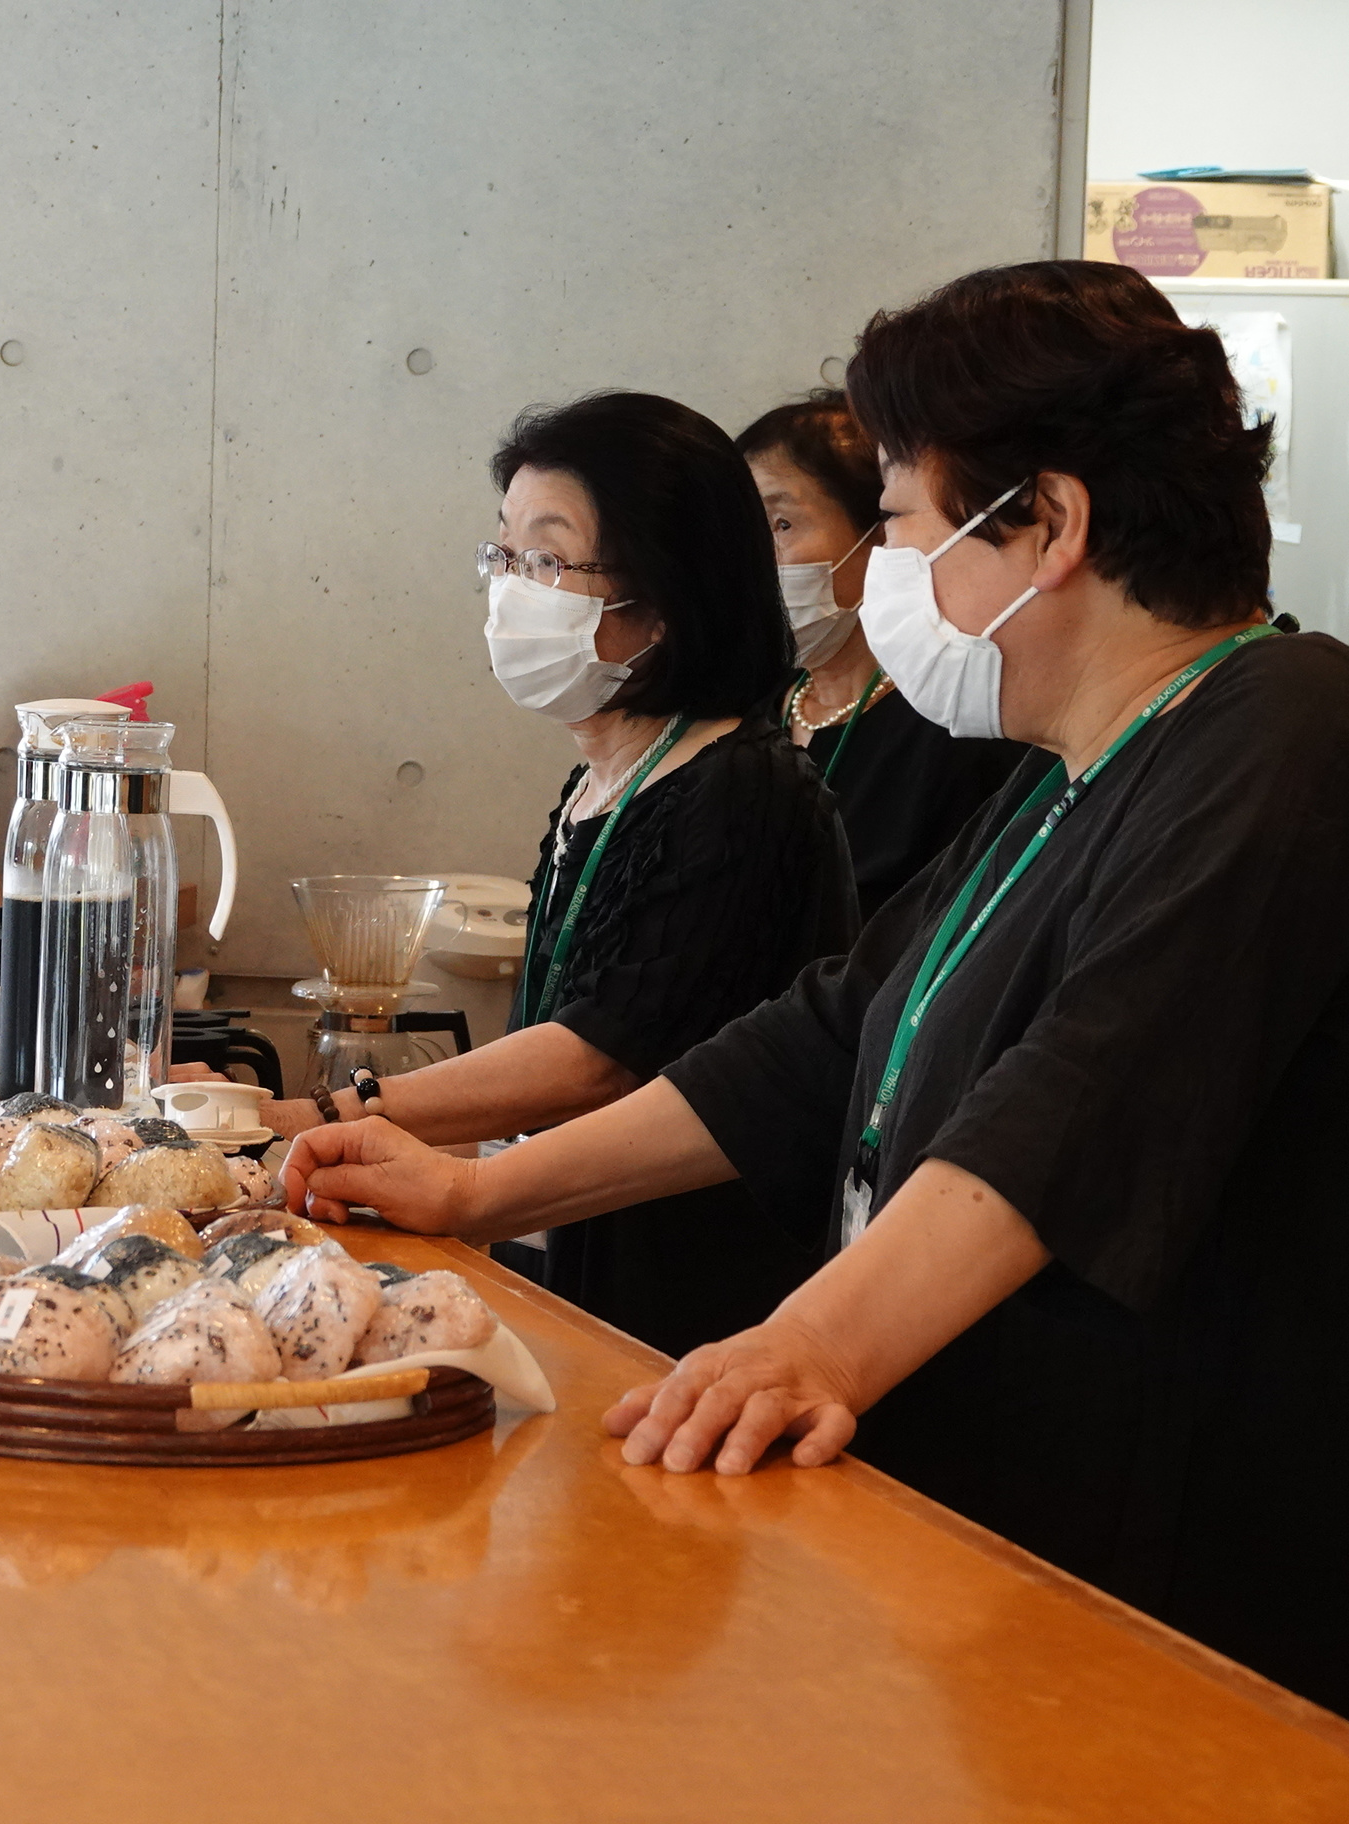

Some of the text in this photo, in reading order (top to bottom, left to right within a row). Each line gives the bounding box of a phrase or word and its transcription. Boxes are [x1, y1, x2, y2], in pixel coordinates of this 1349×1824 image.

[1151, 668, 1200, 711] EZUKO HALL
[883, 1067, 901, 1091] HALL
